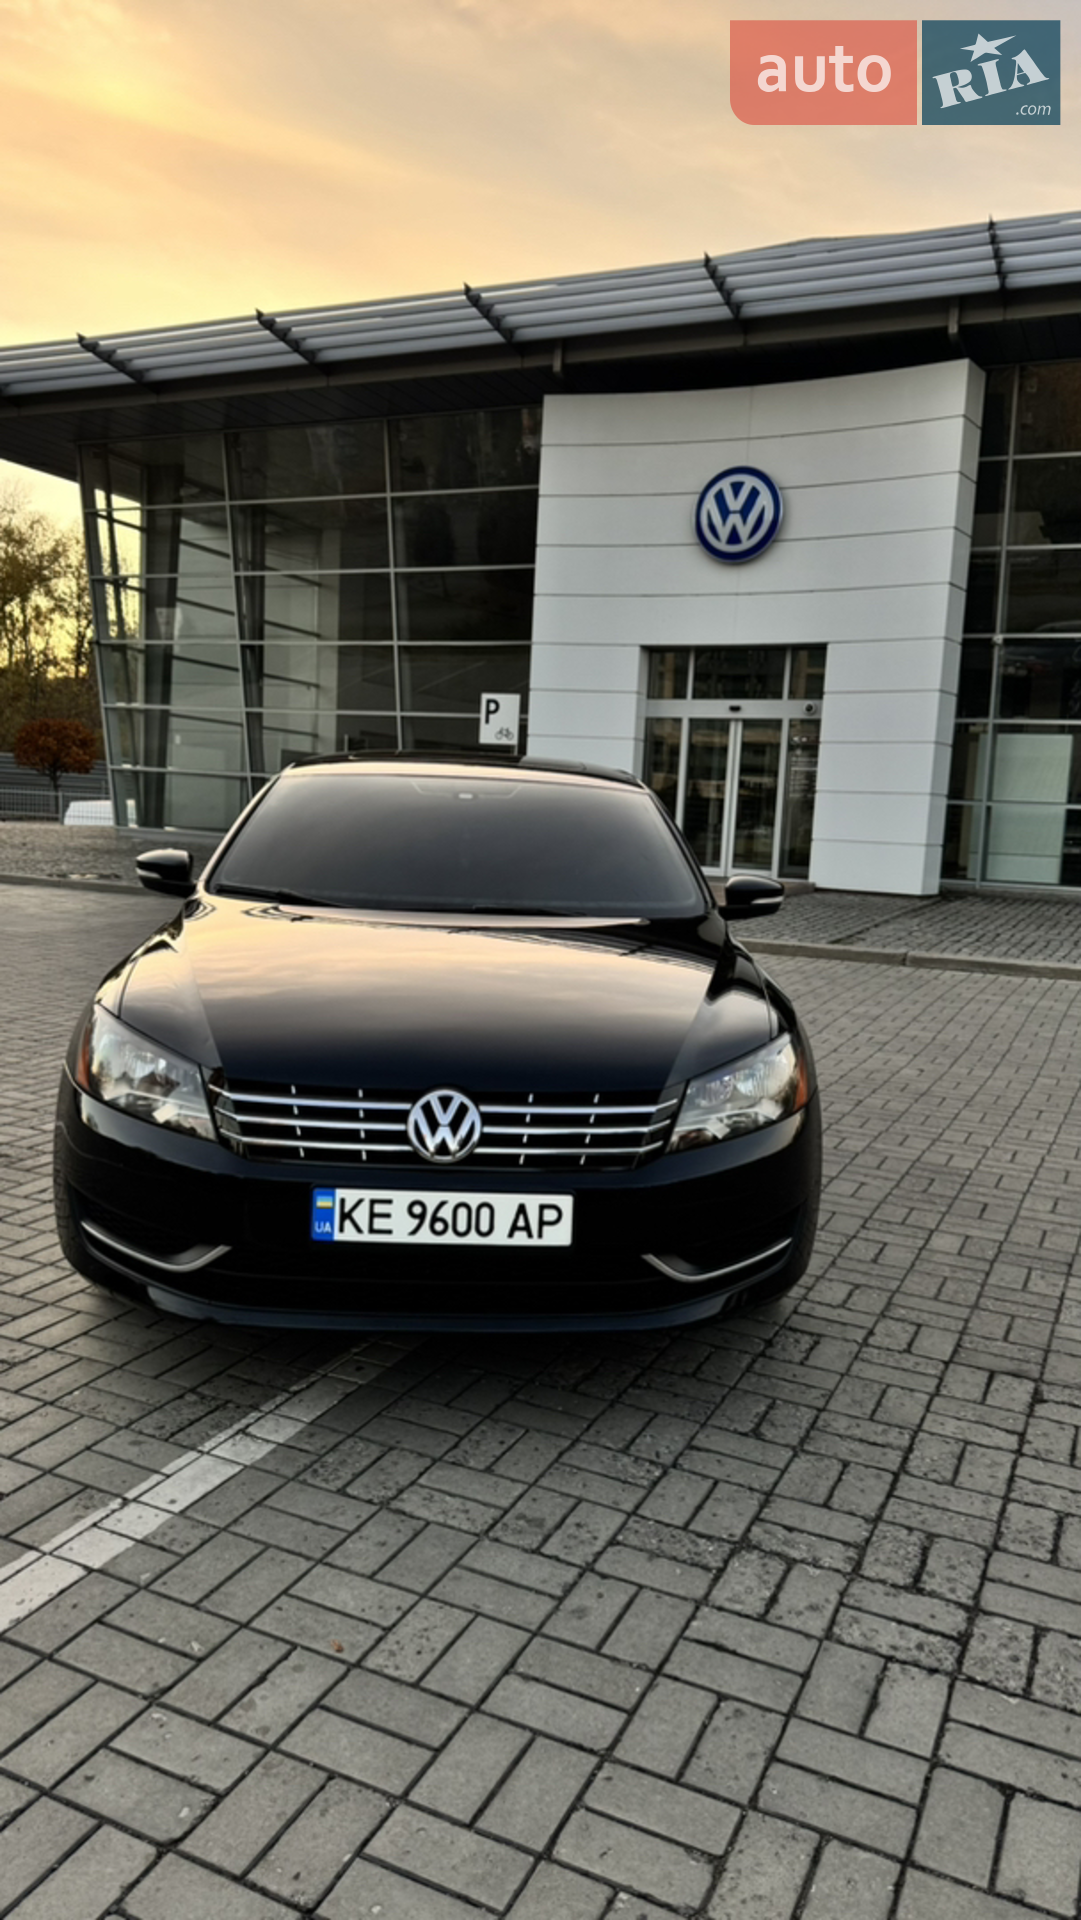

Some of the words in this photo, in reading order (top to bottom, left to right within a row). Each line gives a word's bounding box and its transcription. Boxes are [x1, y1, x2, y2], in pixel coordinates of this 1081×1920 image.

[701, 474, 774, 552] VW
[485, 698, 500, 725] P
[409, 1091, 481, 1160] VW
[315, 1221, 332, 1234] UA
[339, 1197, 394, 1235] KE
[407, 1199, 495, 1238] 9600
[507, 1203, 563, 1239] AP
